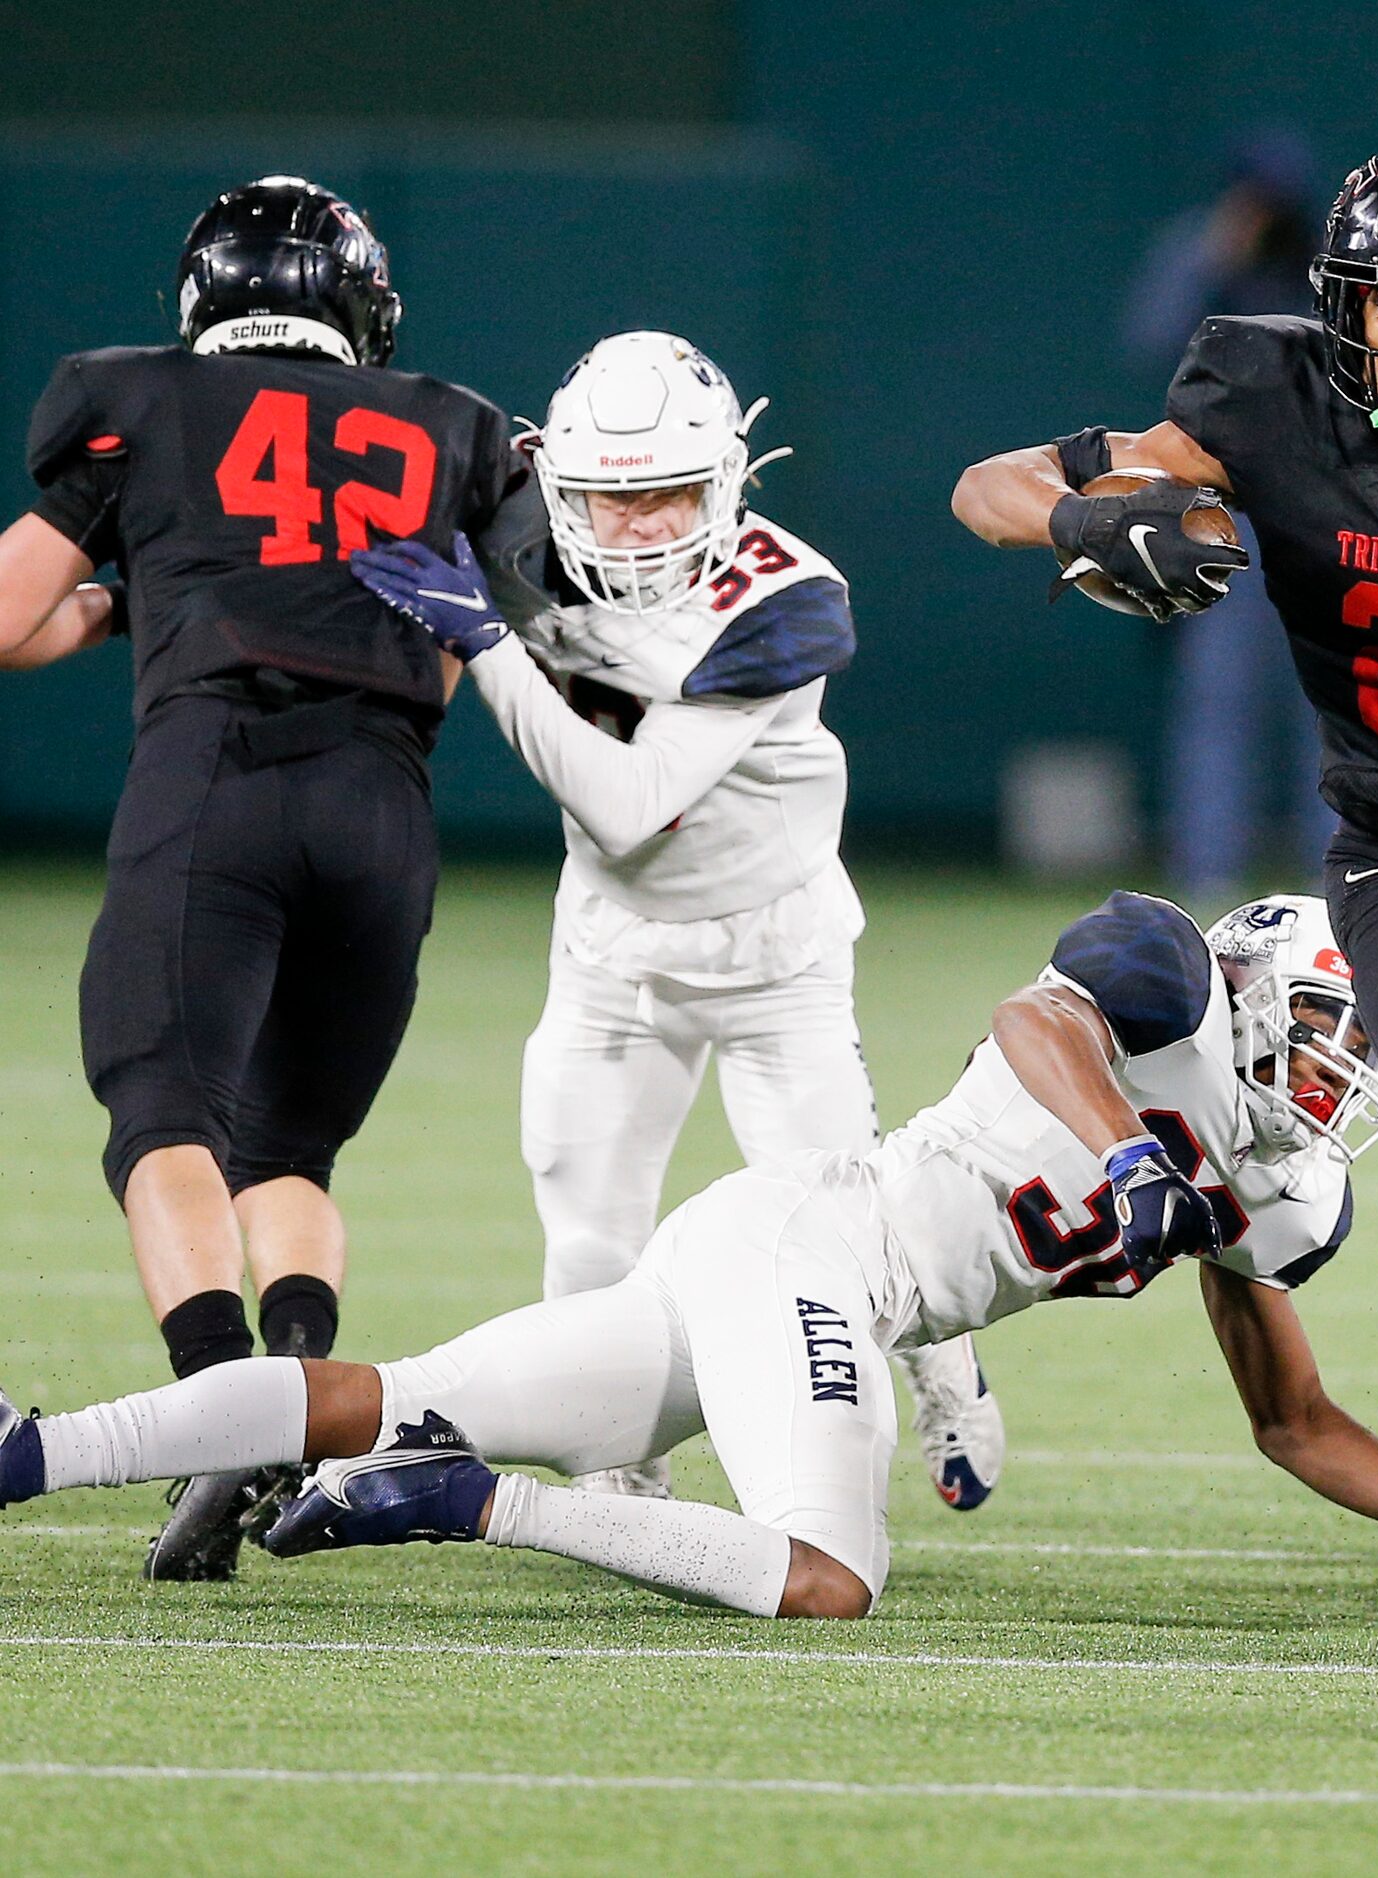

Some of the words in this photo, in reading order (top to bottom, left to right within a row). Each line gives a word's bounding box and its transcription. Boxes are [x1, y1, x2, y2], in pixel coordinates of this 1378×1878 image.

[230, 320, 290, 341] schutt
[215, 389, 437, 567] 42
[599, 454, 653, 467] Riddell
[796, 1297, 858, 1406] ALLEN
